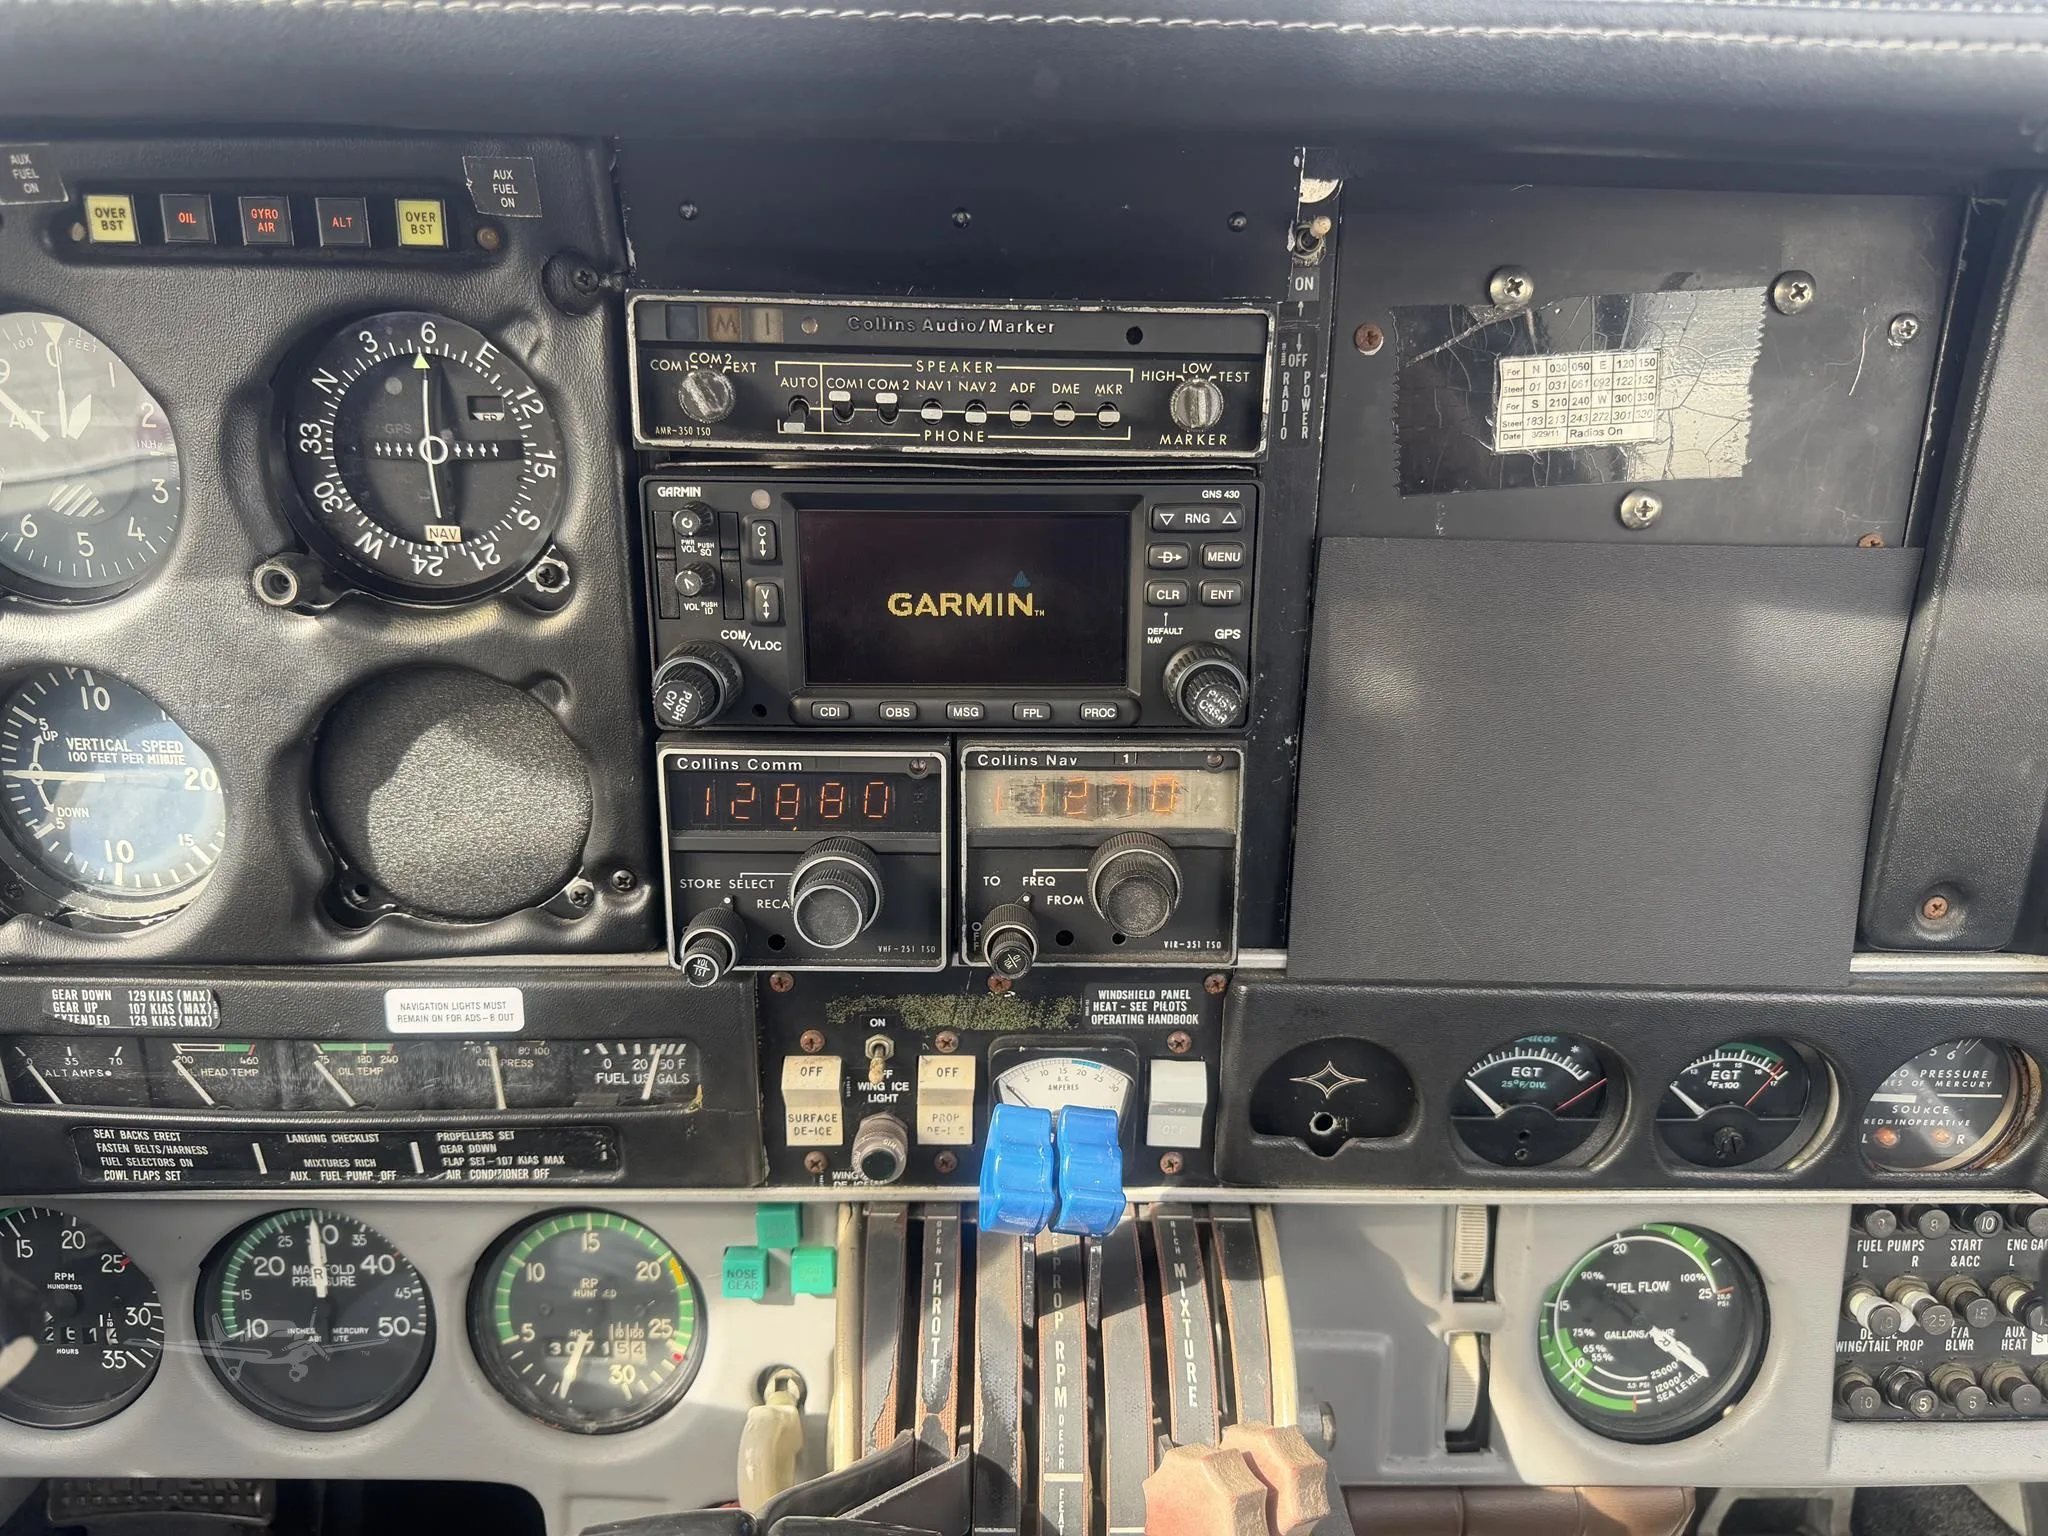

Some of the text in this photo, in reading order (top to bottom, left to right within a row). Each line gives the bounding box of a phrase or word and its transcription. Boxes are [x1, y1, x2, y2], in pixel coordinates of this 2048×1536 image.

[493, 170, 513, 181] AUX
[493, 183, 518, 195] FUEL
[501, 198, 515, 208] ON
[95, 208, 126, 219] OVER
[179, 213, 196, 223] OIL
[251, 209, 278, 220] GYRO
[405, 212, 436, 223] OVER
[102, 220, 124, 231] BST
[258, 221, 276, 233] AIR
[332, 217, 352, 228] ALT
[411, 224, 432, 235] BST
[1295, 277, 1314, 290] ON
[848, 316, 1055, 333] Collins Audio/Marker
[420, 322, 436, 343] 6
[1289, 354, 1308, 367] OFF
[1617, 359, 1633, 368] 120
[1639, 358, 1655, 366] 150
[734, 362, 756, 373] EXT
[916, 361, 993, 373] SPEAKER
[1182, 363, 1211, 373] LOW
[1142, 371, 1175, 381] HIGH
[1219, 372, 1249, 382] TEST
[781, 377, 818, 388] AUTO
[1009, 383, 1035, 393] ADF
[1052, 383, 1079, 394] DME
[1095, 384, 1122, 394] MKR
[515, 386, 544, 417] 12
[1280, 372, 1289, 440] RADIO
[1301, 372, 1311, 439] POWER
[1550, 398, 1567, 407] 210
[1526, 417, 1543, 425] 183
[656, 426, 693, 436] AMR-350
[924, 430, 984, 441] PHONE
[1532, 430, 1559, 438] 3/29/11
[1570, 429, 1604, 438] Radios
[1608, 427, 1623, 436] On
[301, 423, 322, 453] 33
[1160, 434, 1227, 445] MARKER
[534, 449, 556, 478] 15
[658, 487, 701, 497] GARMIN
[1202, 490, 1222, 498] GNS
[1185, 514, 1210, 524] RNG
[429, 528, 458, 539] NAV
[1208, 552, 1240, 562] MENU
[1157, 590, 1179, 600] CLR
[1210, 590, 1233, 600] ENT
[888, 592, 1033, 616] GARMIN
[1215, 629, 1241, 639] GPS
[820, 708, 840, 716] CDI
[886, 708, 910, 718] OBS
[953, 707, 979, 717] MSG
[1023, 708, 1043, 718] FPL
[1084, 708, 1115, 718] PROC
[44, 731, 58, 742] UP
[66, 737, 183, 754] VERTICAL SPEED
[68, 751, 186, 765] 100 FEET PER MINUTE
[978, 755, 1077, 766] Collins Nav
[677, 758, 802, 771] Collins Comm
[185, 767, 218, 791] 20
[57, 808, 89, 819] DOWN
[680, 880, 774, 889] STORE SELECT
[983, 877, 1055, 886] TO FREQ
[1047, 896, 1083, 905] FROM
[52, 989, 212, 1002] GEAR DOWN 129 KIAS (MAX)
[1098, 990, 1191, 1000] WINDSHIELD PANEL
[401, 1002, 506, 1011] NAVIGATION LIGHTS MUST
[1093, 1001, 1117, 1012] HEAT
[1130, 1002, 1150, 1012] SEE
[1154, 1001, 1187, 1011] PILOTS
[432, 1014, 444, 1022] ON
[447, 1014, 462, 1022] FOR
[498, 1013, 514, 1022] OUT
[870, 1018, 885, 1027] ON
[1091, 1013, 1199, 1025] OPERATING HANDBOOK
[201, 1068, 258, 1076] HEAD TEMP
[800, 1066, 823, 1077] OFF
[937, 1067, 958, 1077] OFF
[1511, 1067, 1542, 1077] EGT
[1711, 1070, 1740, 1080] EGT
[1920, 1069, 1987, 1079] PRESSURE
[597, 1073, 689, 1084] FUEL GALS
[857, 1082, 887, 1091] WING
[891, 1082, 909, 1091] ICE
[868, 1093, 898, 1103] LIGHT
[1892, 1104, 1949, 1114] SOURCE
[788, 1113, 838, 1122] SURFACE
[94, 1129, 180, 1141] SEAT BACKS ERECT
[437, 1131, 515, 1141] PROPELLERS SET
[794, 1127, 832, 1136] DE-ICE
[286, 1133, 379, 1143] LANDING CHECKLIST
[97, 1143, 208, 1155] FASTEN BELTS/HARNESS
[304, 1158, 376, 1168] MIXTURES RICH
[321, 1170, 397, 1181] FUEL PUMP OFF
[1613, 1244, 1627, 1254] 20
[1857, 1240, 1925, 1251] FUEL PUMPS
[1951, 1240, 1983, 1250] START
[2008, 1239, 2027, 1250] ENG
[361, 1255, 395, 1274] 40
[636, 1261, 660, 1280] 20
[727, 1269, 757, 1279] NOSE
[55, 1273, 75, 1281] RPM
[1681, 1274, 1706, 1282] 100%
[1639, 1281, 1670, 1291] FLOW
[1699, 1289, 1713, 1299] 25
[378, 1317, 411, 1336] 50
[2005, 1326, 2025, 1337] AUX
[1174, 1263, 1198, 1407] MIXTURE
[1952, 1327, 1969, 1338] F/A
[1836, 1340, 1923, 1352] WING/TAIL PROP
[1946, 1340, 1974, 1351] BLWR
[2002, 1339, 2027, 1350] HEAT
[1055, 1341, 1067, 1408] RPM
